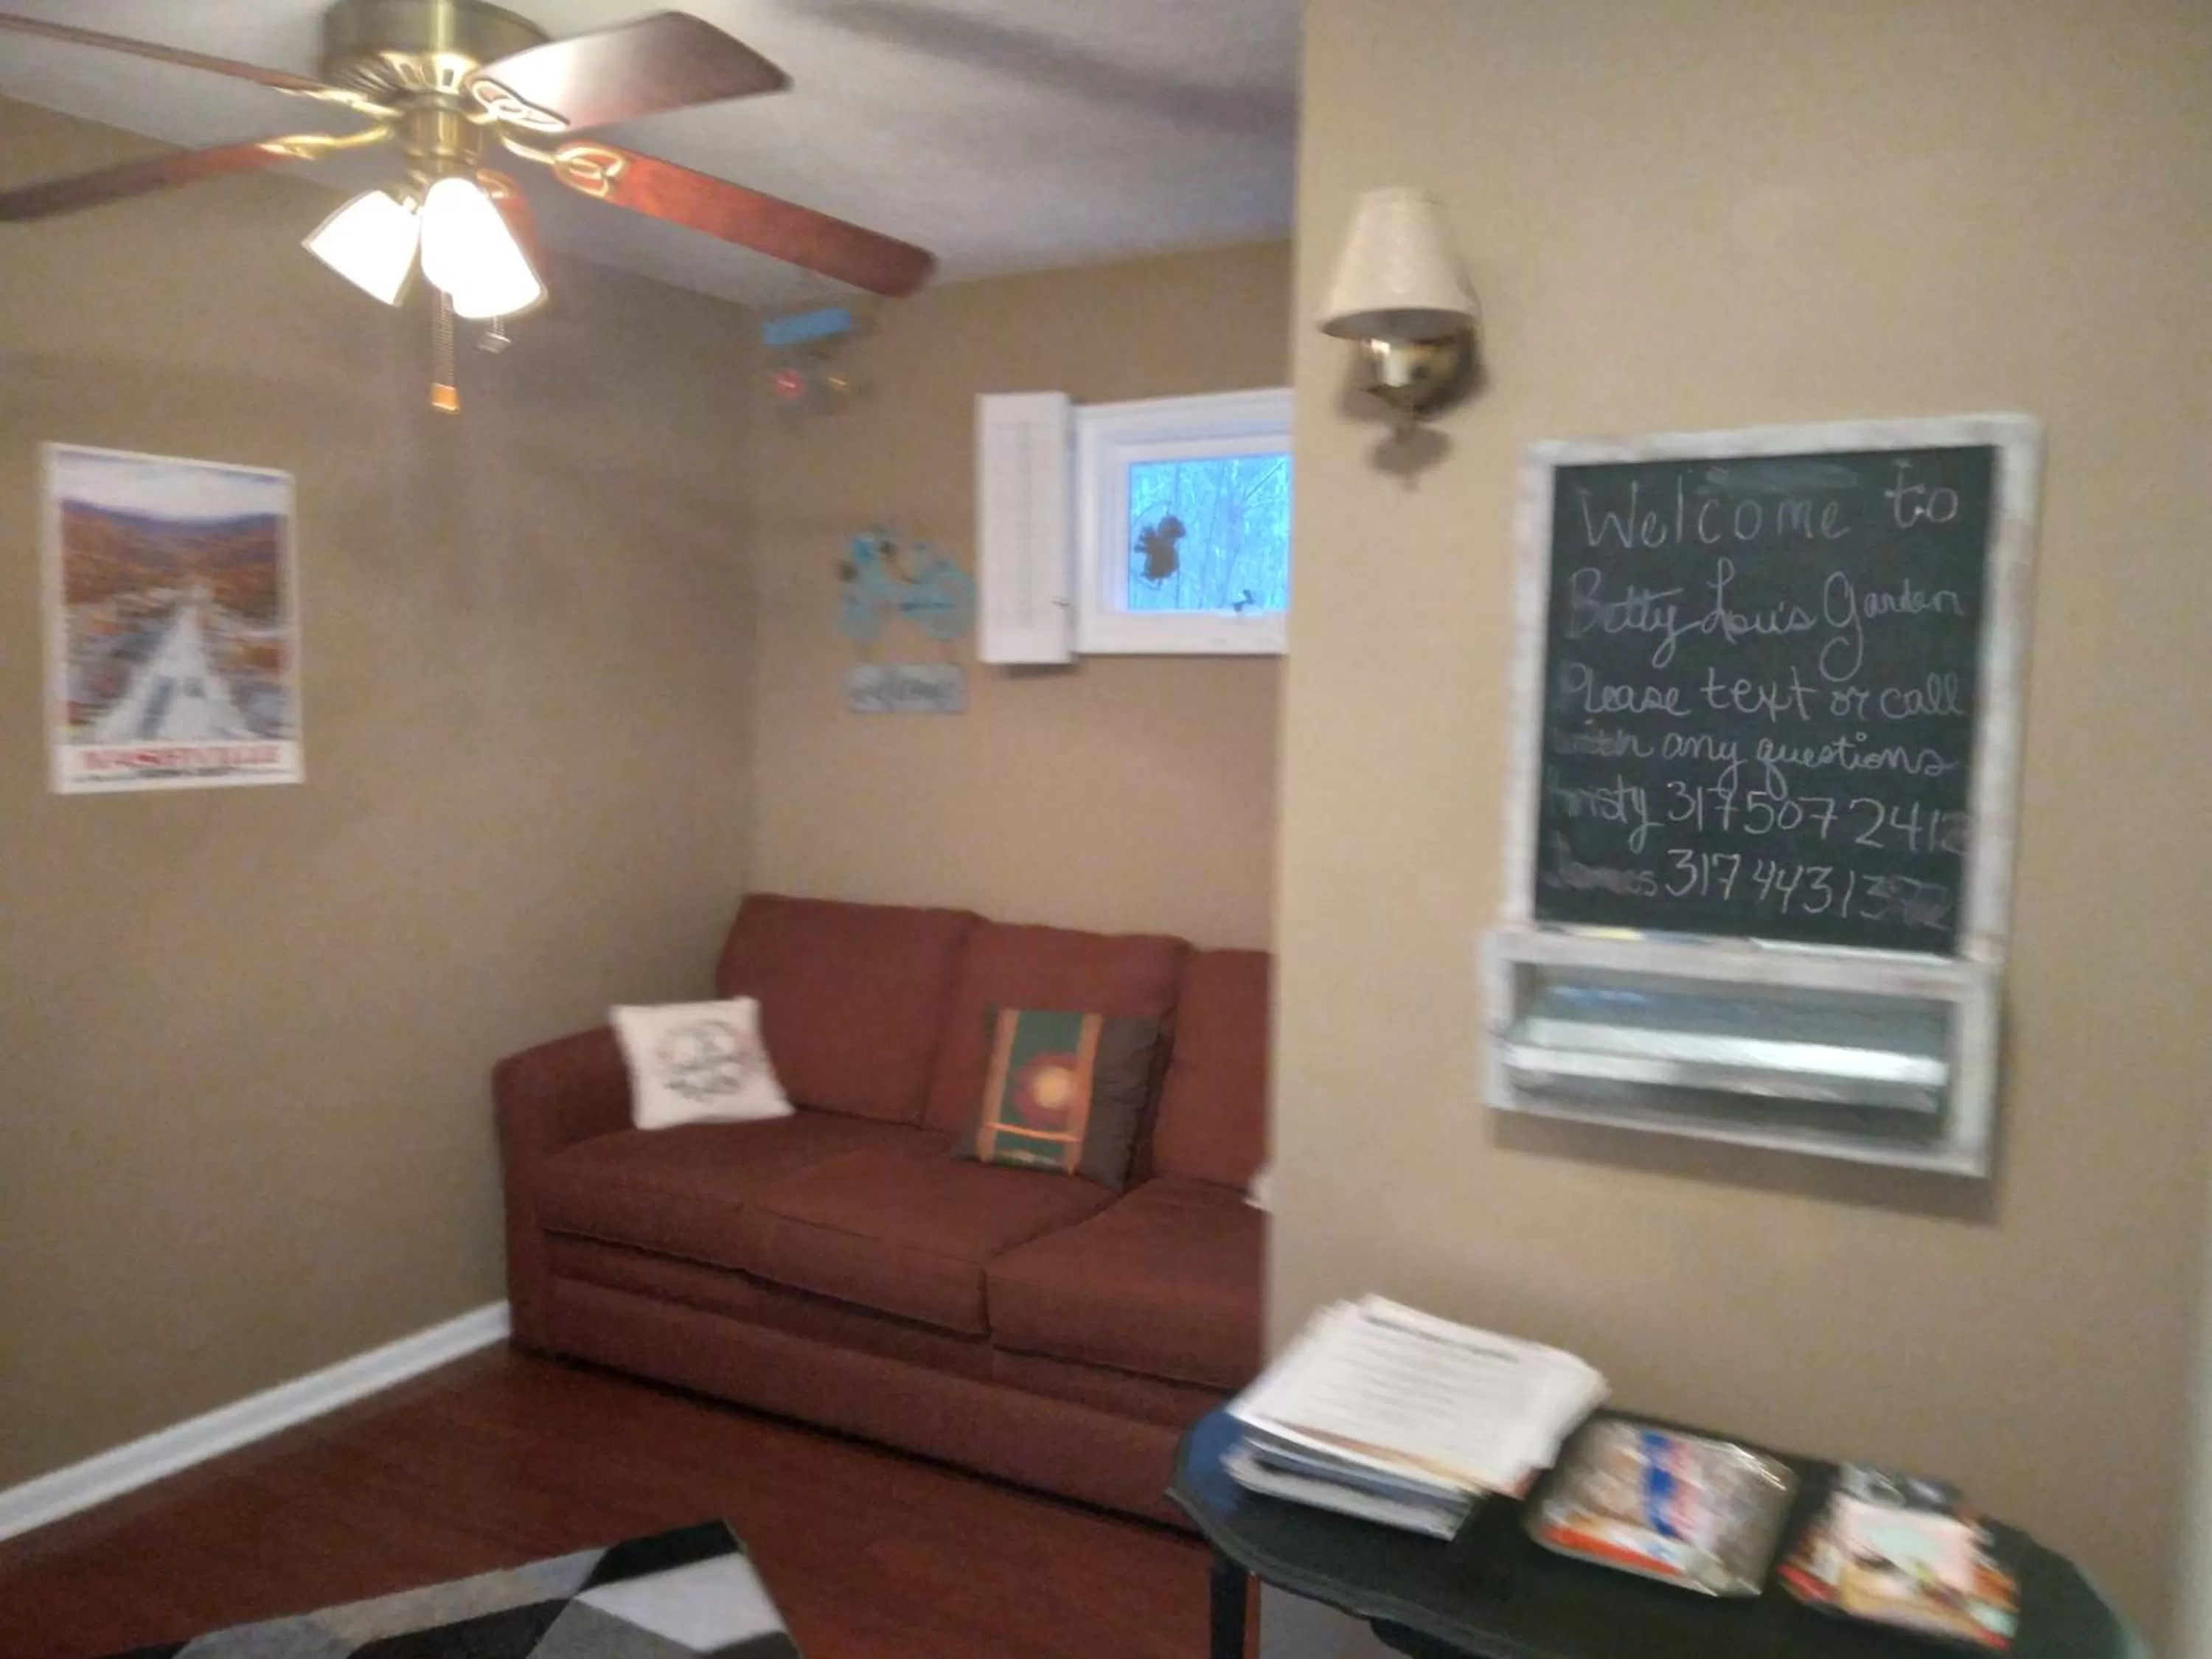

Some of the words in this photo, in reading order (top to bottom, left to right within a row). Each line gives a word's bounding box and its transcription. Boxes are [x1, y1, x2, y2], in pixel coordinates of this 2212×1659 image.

[1576, 475, 1849, 549] Welcome
[1885, 457, 1959, 529] to
[1556, 661, 1691, 716] Please
[1700, 666, 1818, 723] text
[1830, 686, 1871, 720] or
[1879, 672, 1967, 720] call
[1662, 731, 1747, 798] any
[1756, 732, 1959, 801] questions
